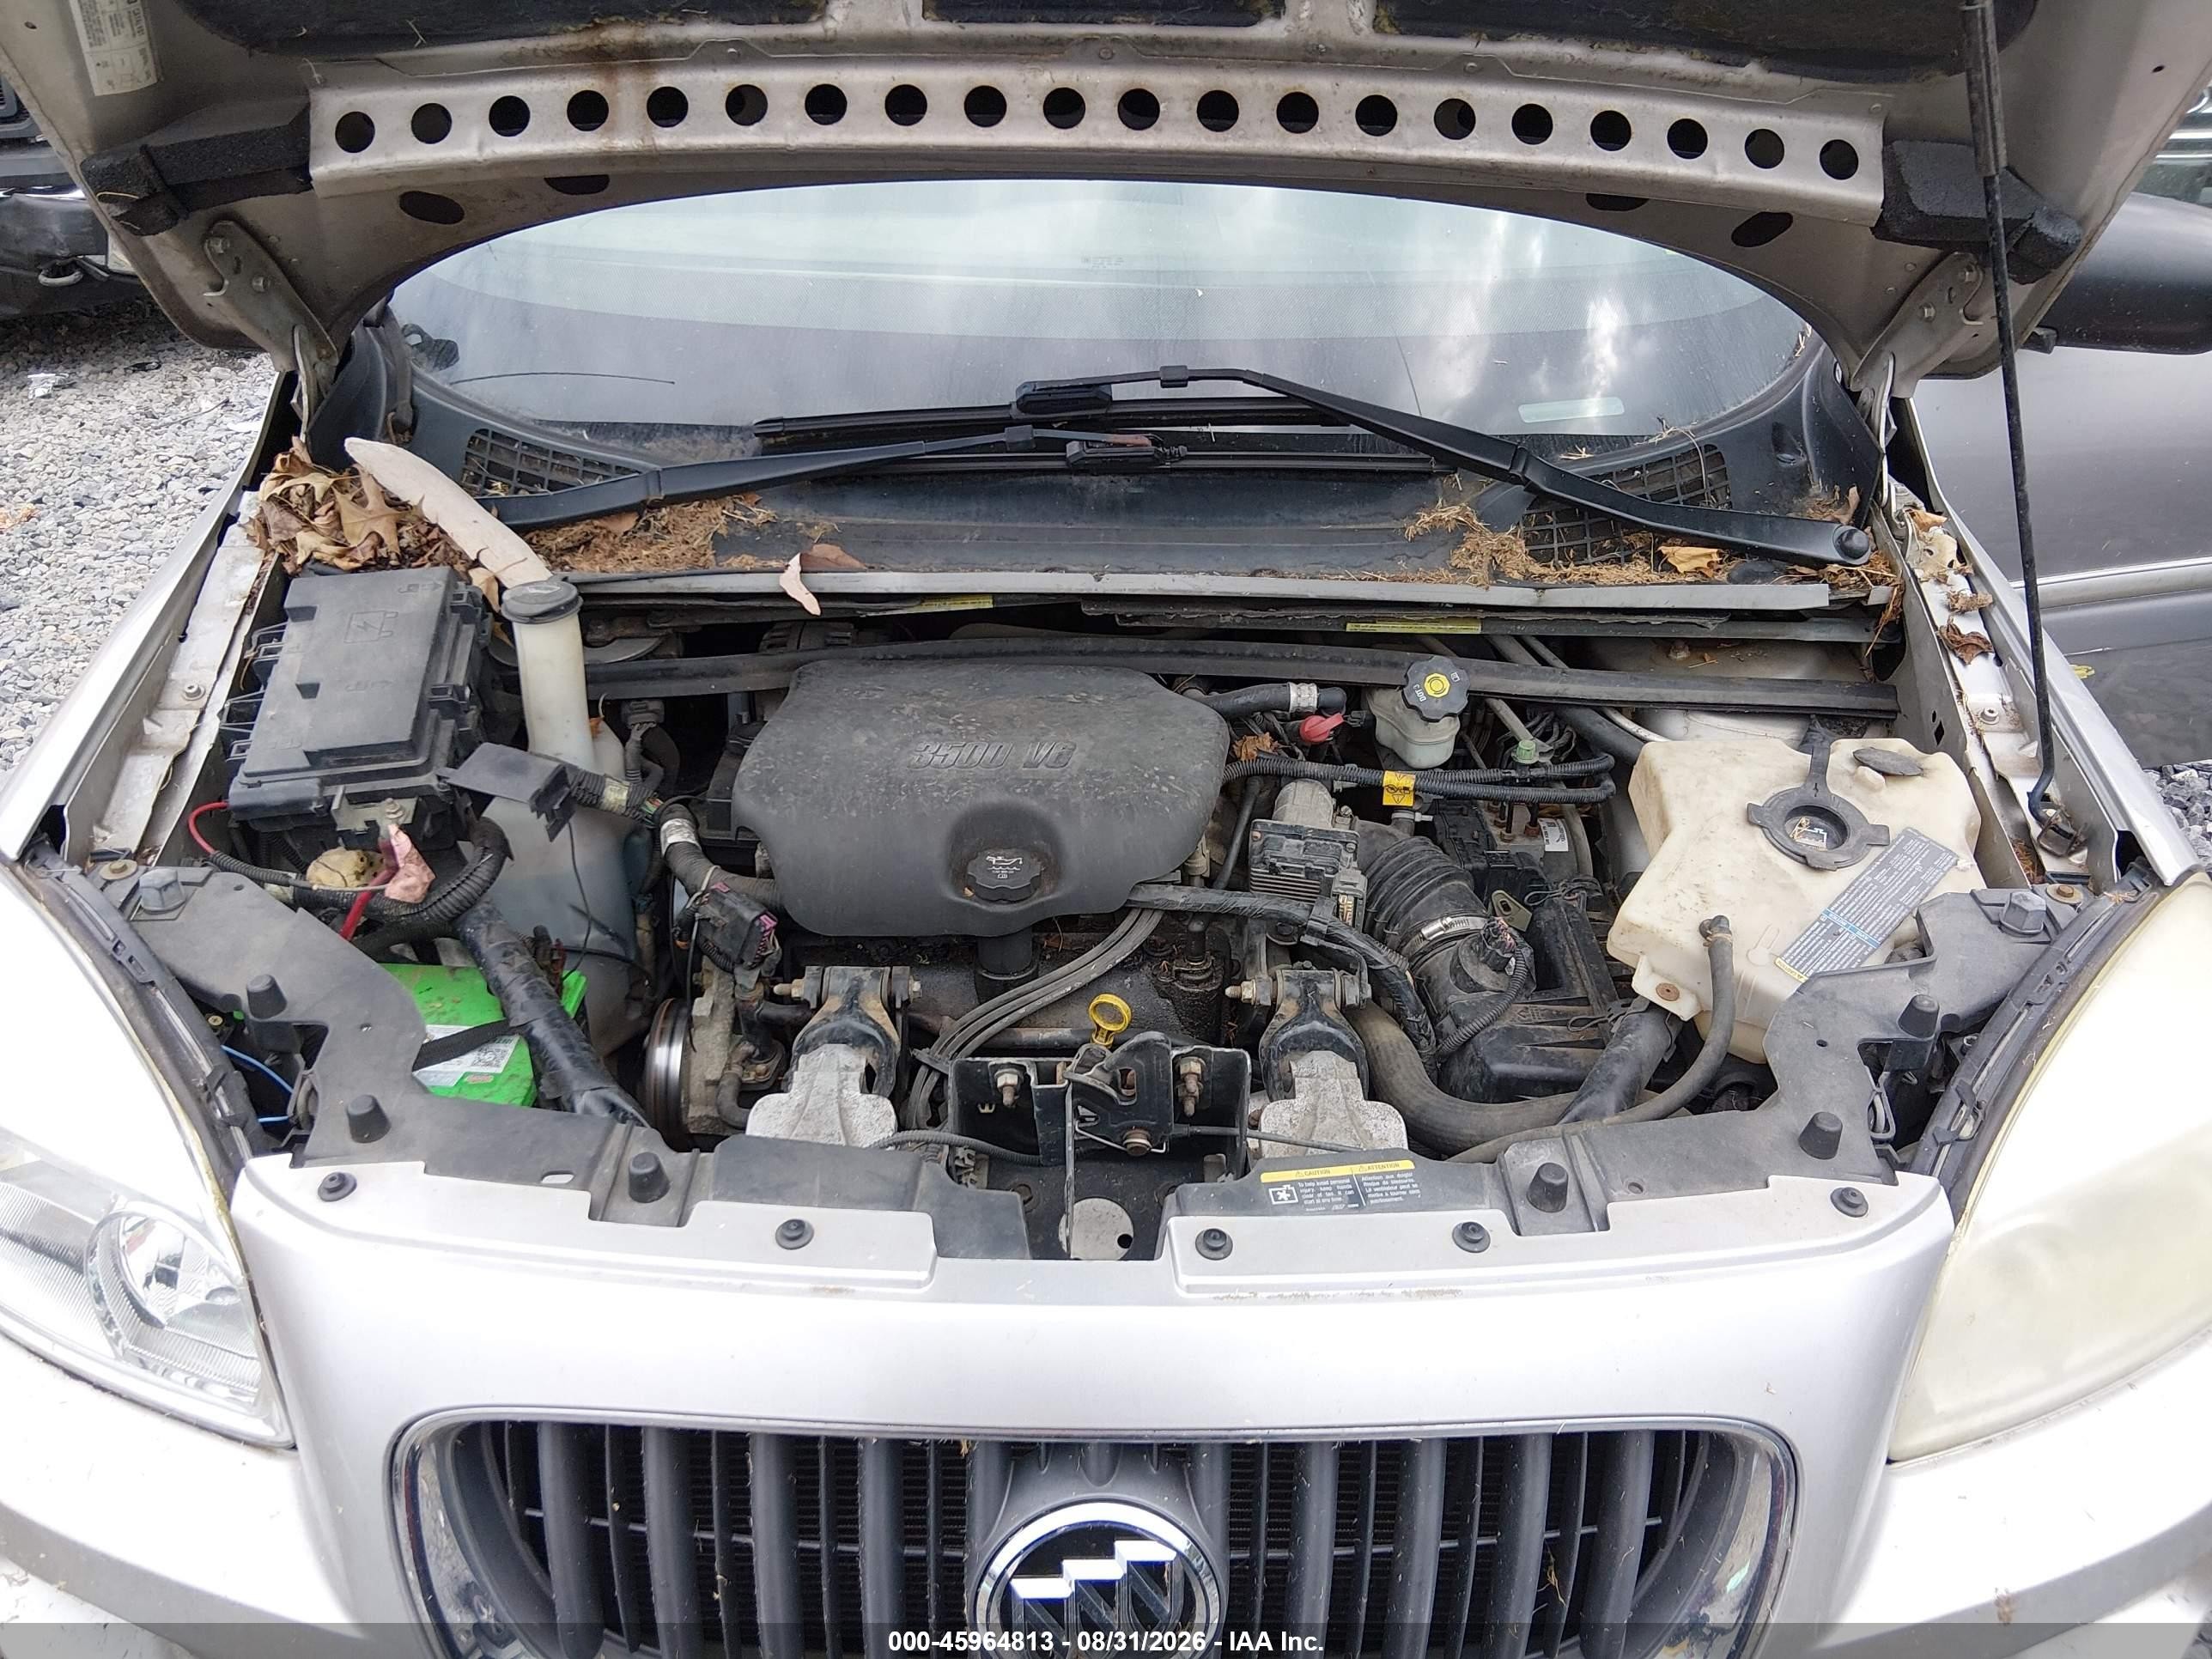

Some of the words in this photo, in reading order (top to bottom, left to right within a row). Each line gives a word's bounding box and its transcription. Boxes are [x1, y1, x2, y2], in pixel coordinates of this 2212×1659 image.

[1415, 689, 1427, 702] DOT
[907, 741, 1015, 769] 3500
[1022, 741, 1077, 769] V6
[1367, 1162, 1401, 1171] ATTENTION
